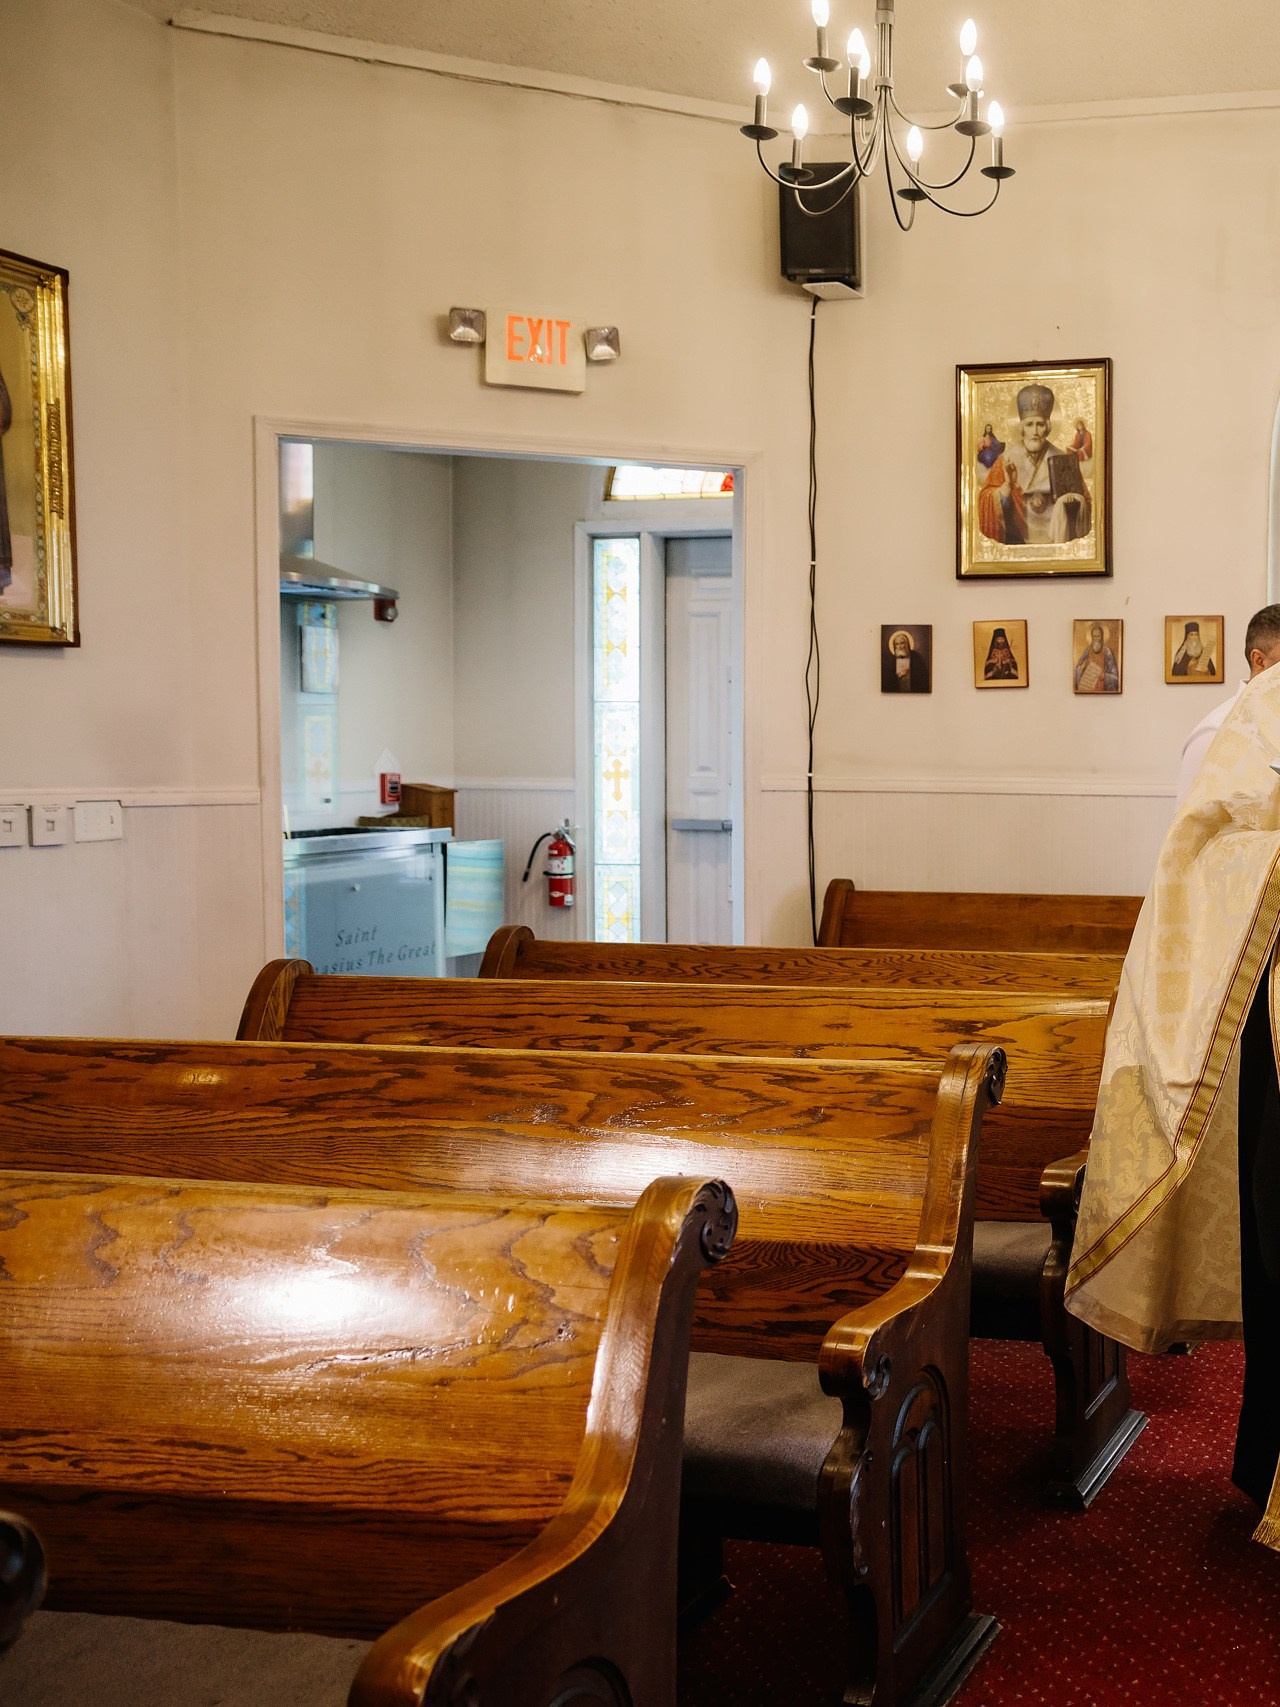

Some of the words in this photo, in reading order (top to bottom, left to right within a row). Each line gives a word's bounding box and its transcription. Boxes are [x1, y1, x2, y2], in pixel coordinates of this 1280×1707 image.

[507, 315, 571, 366] EXIT
[335, 925, 378, 948] Saint
[367, 945, 394, 967] The
[397, 940, 436, 961] Great
